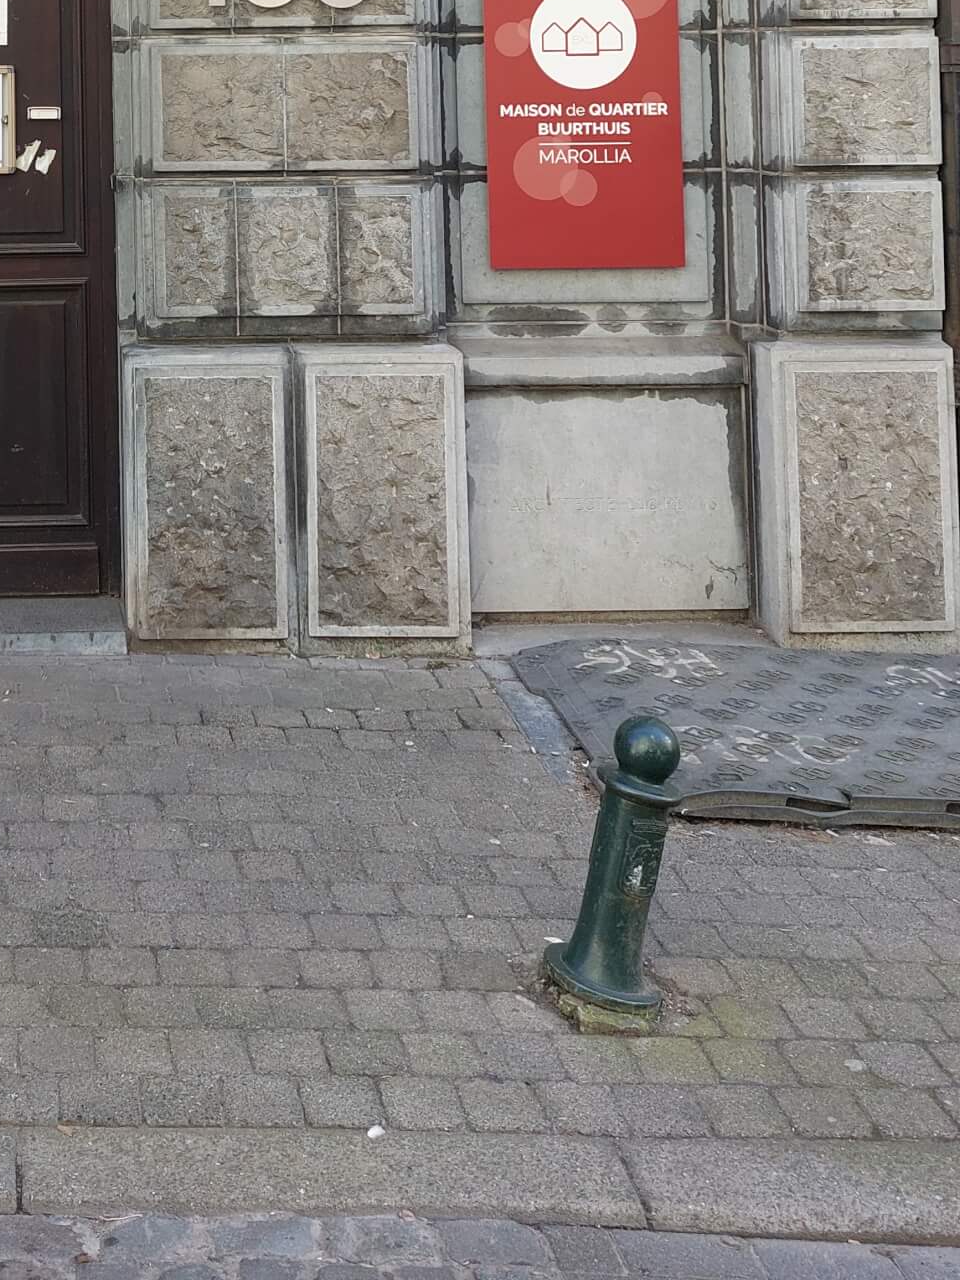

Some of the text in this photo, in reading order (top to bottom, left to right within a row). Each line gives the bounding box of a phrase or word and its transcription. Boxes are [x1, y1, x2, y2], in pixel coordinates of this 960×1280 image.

[499, 102, 669, 117] MAISON de QUARTIER
[537, 121, 632, 136] BUURTHUIS
[538, 148, 633, 164] MAROLLIA
